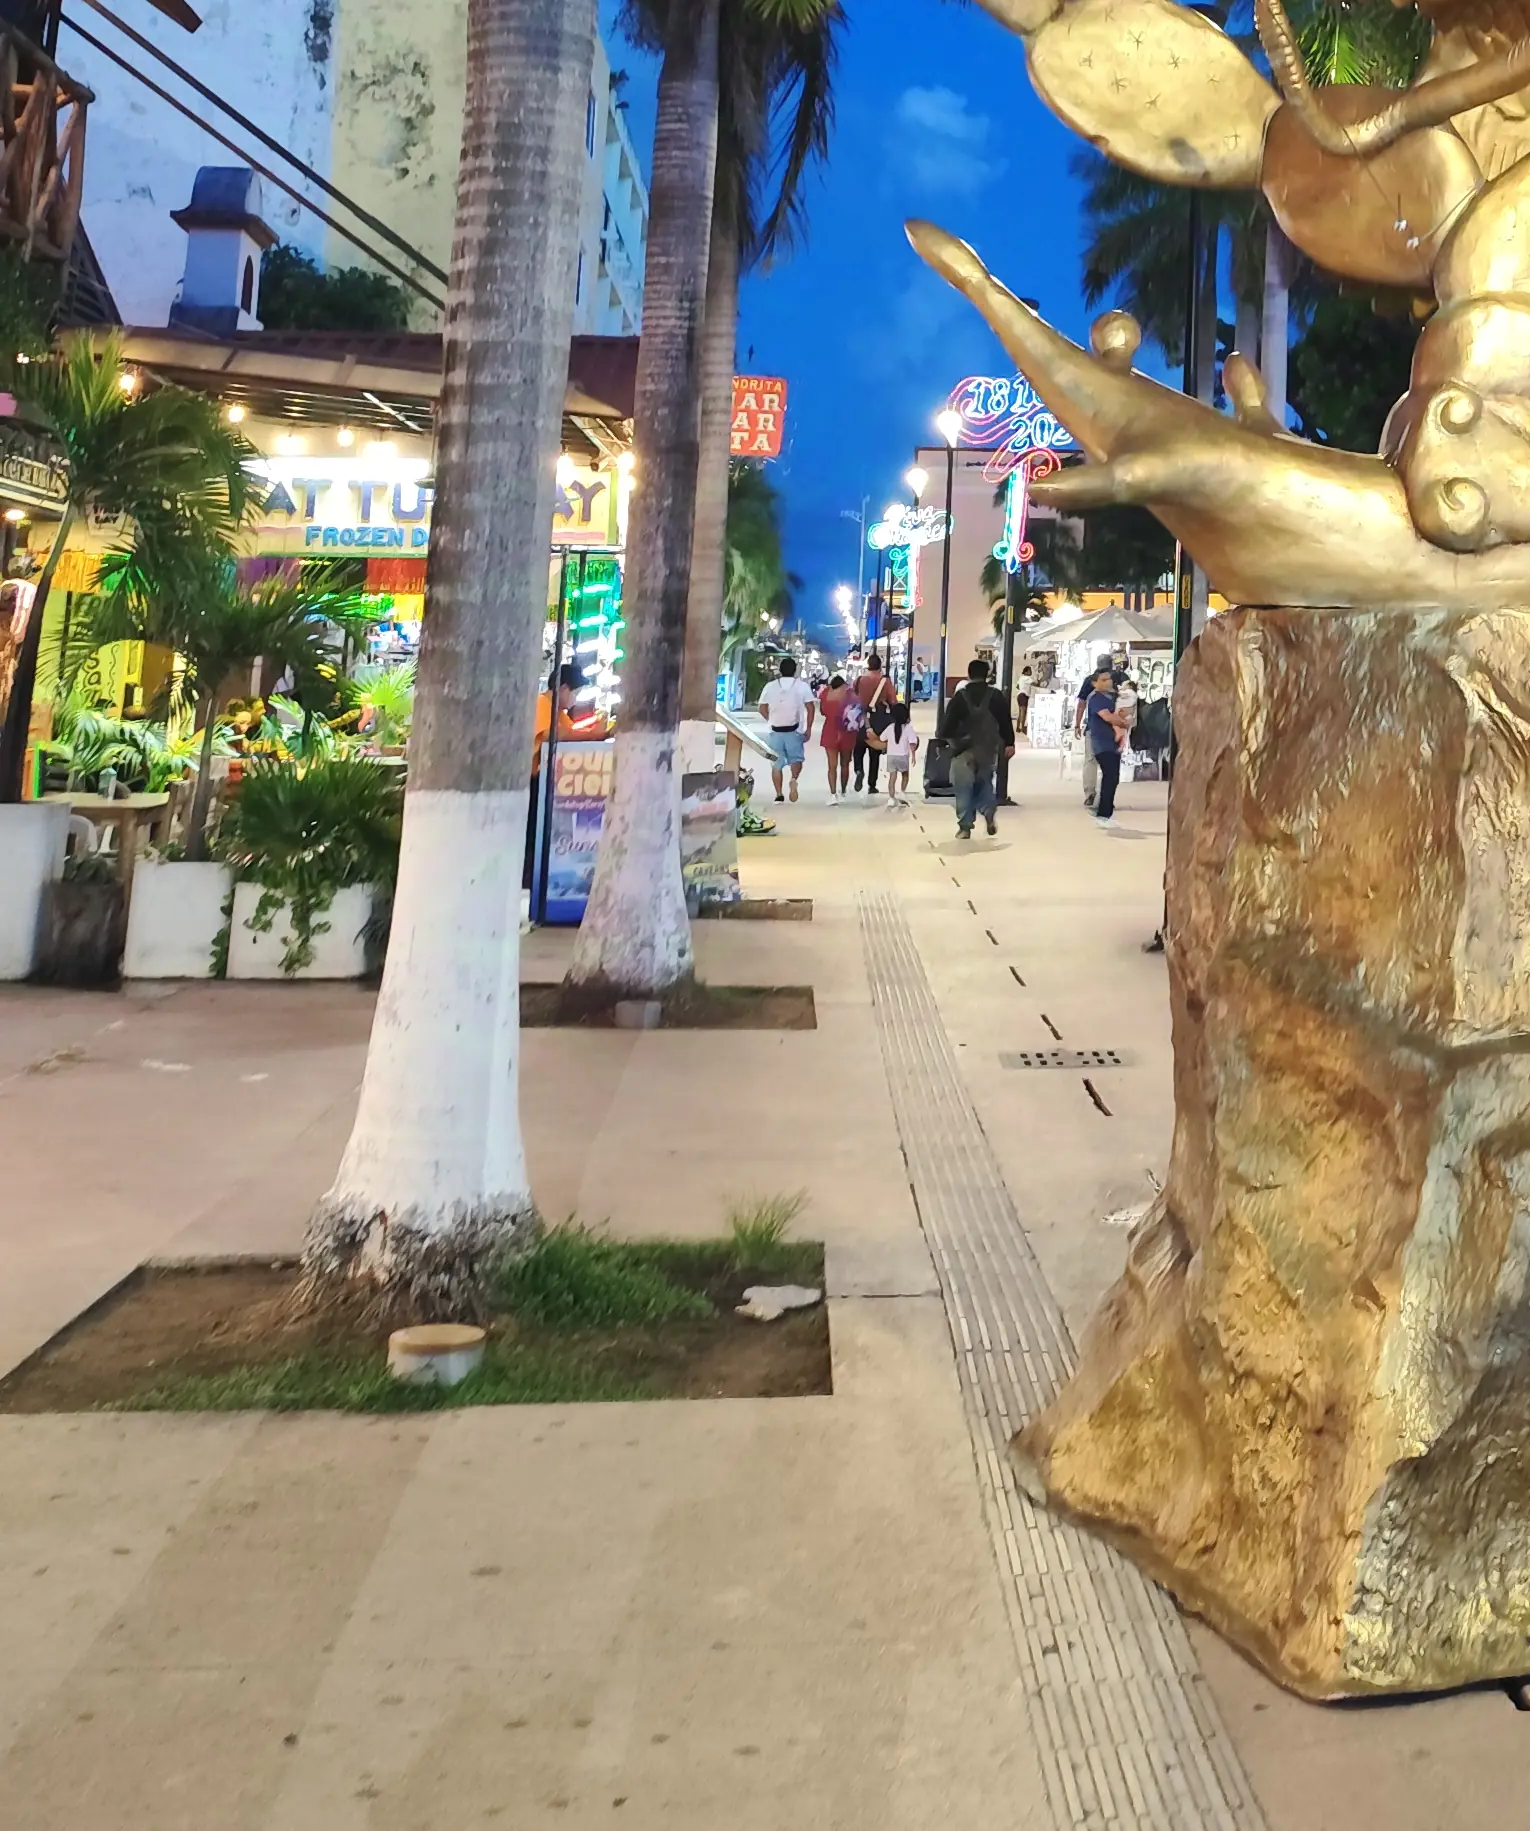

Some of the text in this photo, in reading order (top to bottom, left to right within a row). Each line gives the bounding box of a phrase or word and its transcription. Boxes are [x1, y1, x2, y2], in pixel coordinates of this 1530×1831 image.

[732, 376, 782, 393] ÑORITA
[731, 392, 782, 412] AR
[731, 411, 777, 432] AR
[730, 431, 772, 453] TA
[248, 477, 332, 520] AT
[305, 525, 405, 548] FROZEN
